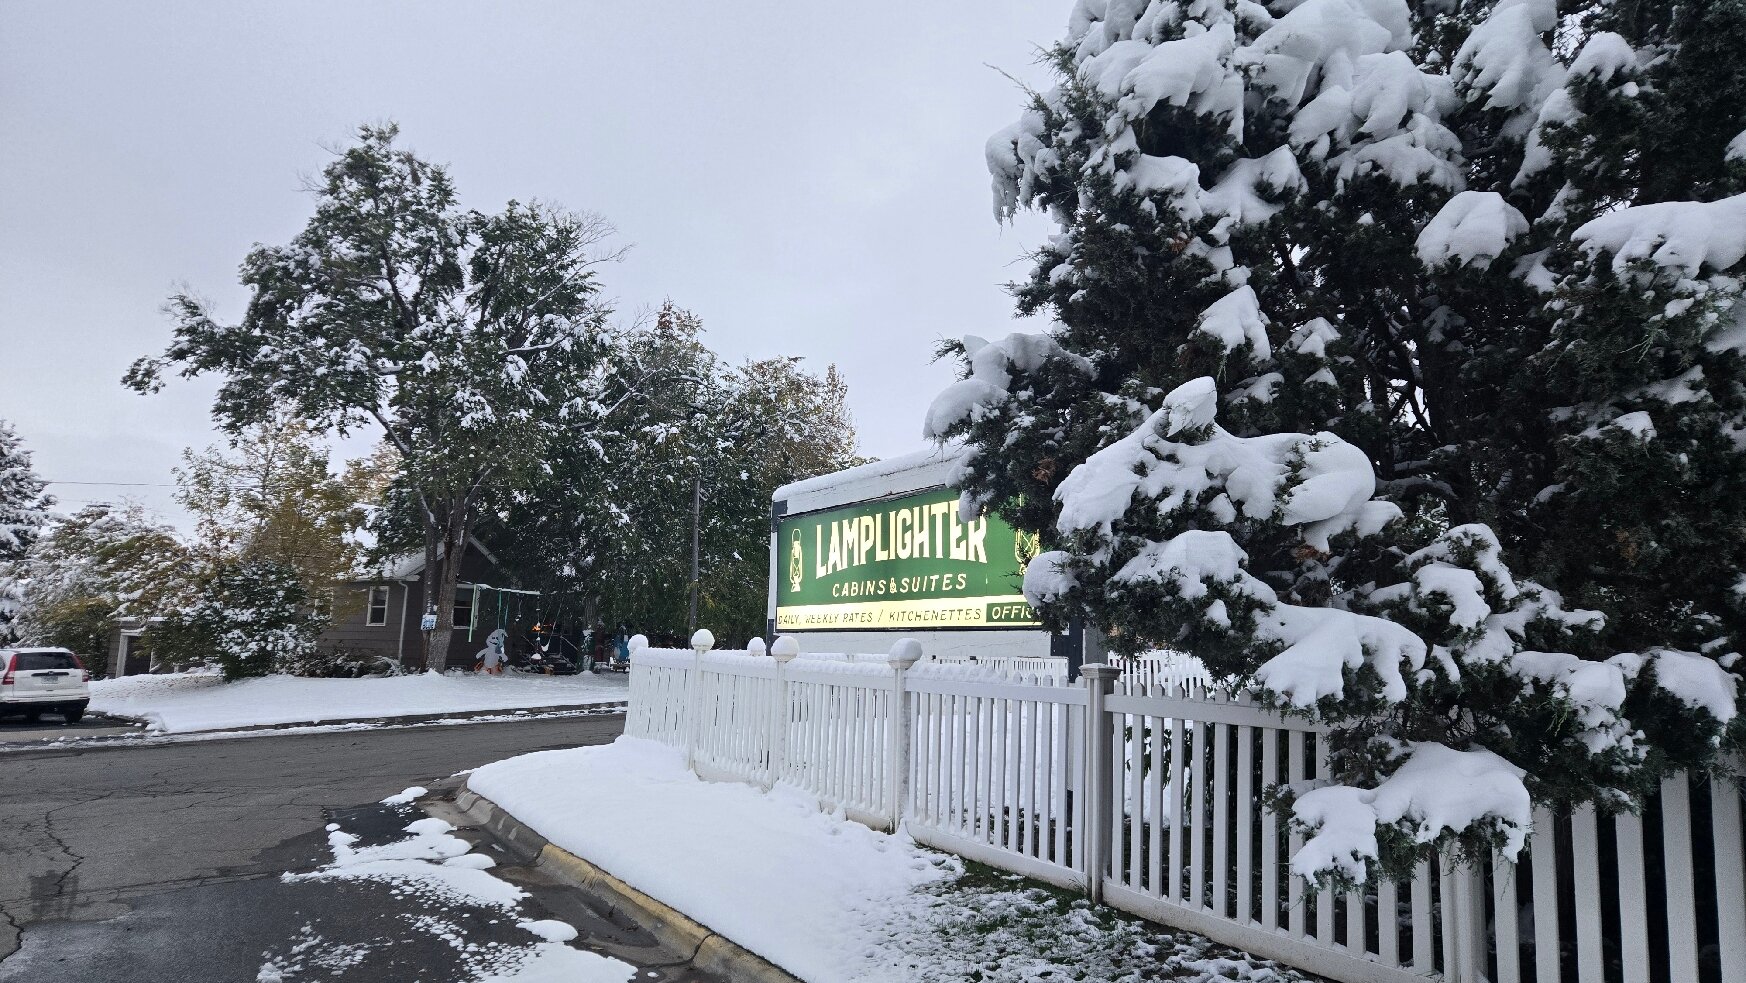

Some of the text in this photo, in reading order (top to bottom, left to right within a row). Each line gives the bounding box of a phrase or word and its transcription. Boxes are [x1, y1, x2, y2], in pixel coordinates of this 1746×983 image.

[815, 500, 988, 580] LAMPLIGHTER
[805, 613, 840, 624] WEEKLY
[843, 612, 873, 623] RATES
[889, 608, 982, 622] KITCHENETTES
[991, 605, 1040, 620] OFFIC
